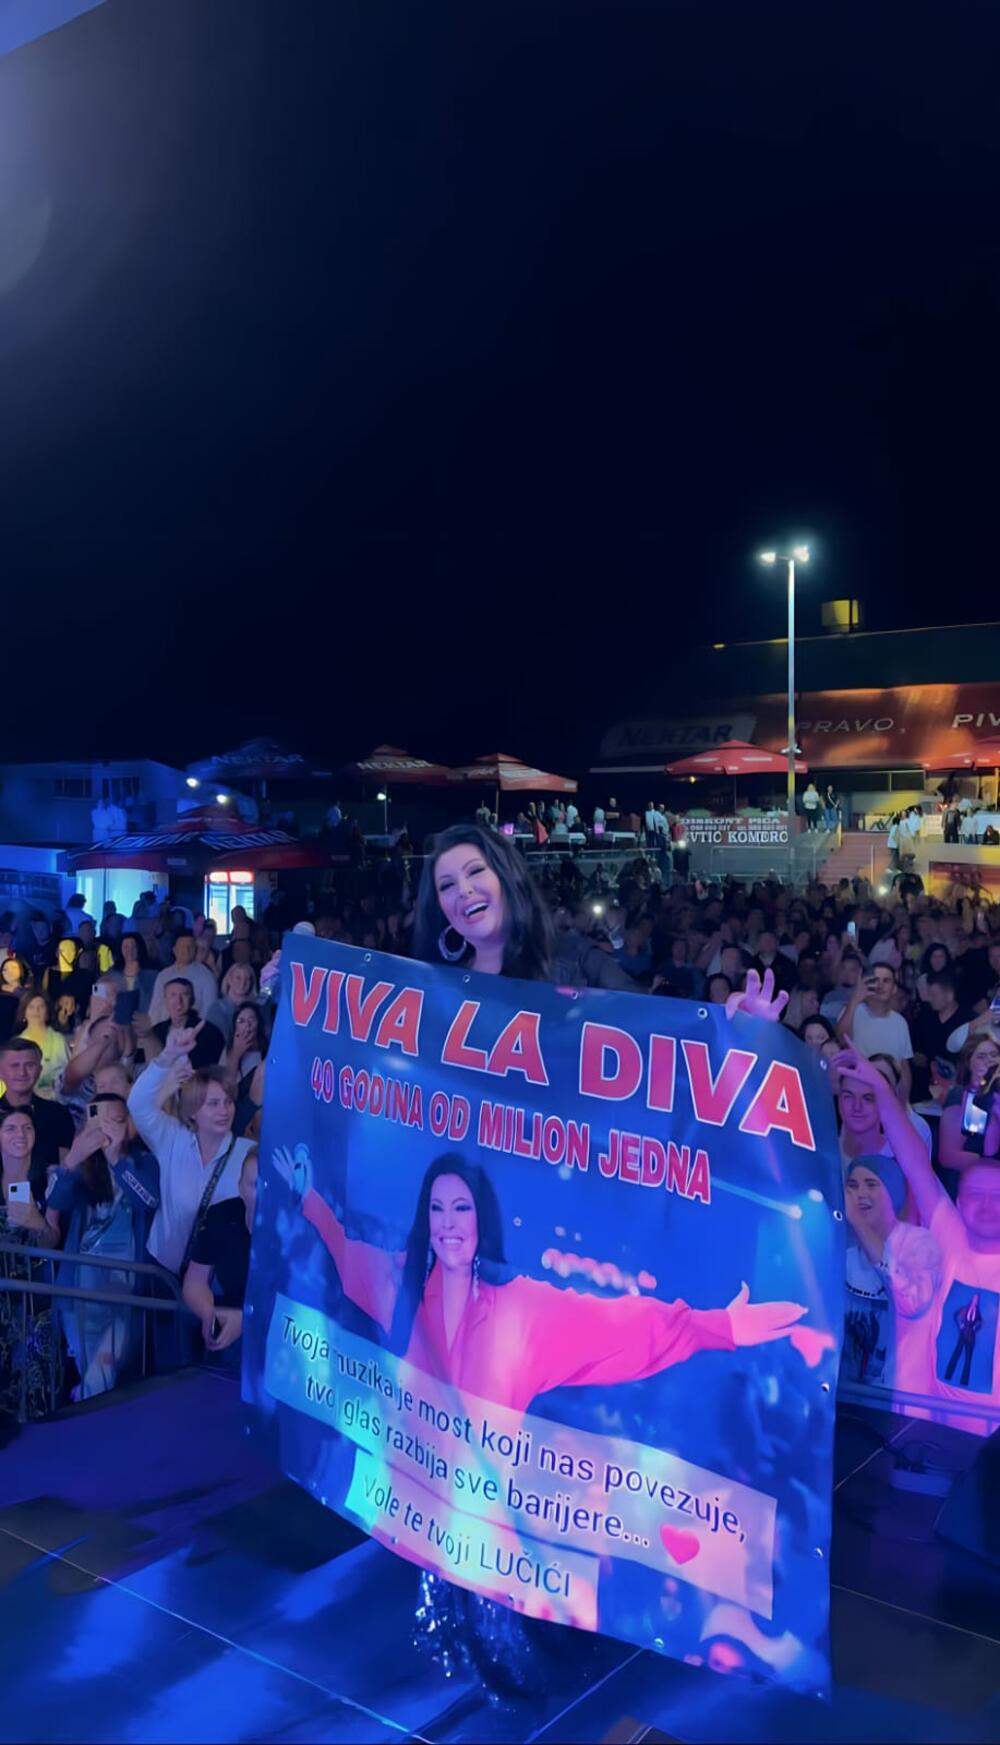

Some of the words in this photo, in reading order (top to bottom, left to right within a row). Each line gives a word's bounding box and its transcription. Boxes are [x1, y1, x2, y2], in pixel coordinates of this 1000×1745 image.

[797, 718, 894, 733] PRAVO
[290, 961, 424, 1056] VIVA
[441, 1000, 549, 1085] LA
[579, 1021, 816, 1151] DIVA
[311, 1056, 334, 1103] 40
[339, 1065, 424, 1130] GODINA
[429, 1091, 470, 1141] OD
[478, 1100, 589, 1171] MILION
[598, 1129, 711, 1205] JEDNA
[283, 1315, 329, 1360] Tvoja
[397, 1382, 413, 1411] je
[419, 1399, 473, 1443] most
[481, 1420, 530, 1467] koji
[539, 1447, 593, 1481] nas
[605, 1463, 746, 1543] povezuje,
[344, 1397, 381, 1436] glas
[386, 1425, 448, 1479] razbija
[454, 1467, 498, 1501] sve
[507, 1478, 649, 1547] barijere...
[365, 1476, 399, 1518] Vole
[404, 1503, 423, 1532] te
[428, 1519, 470, 1565] tvoji
[480, 1543, 570, 1597] LUČIĆI
